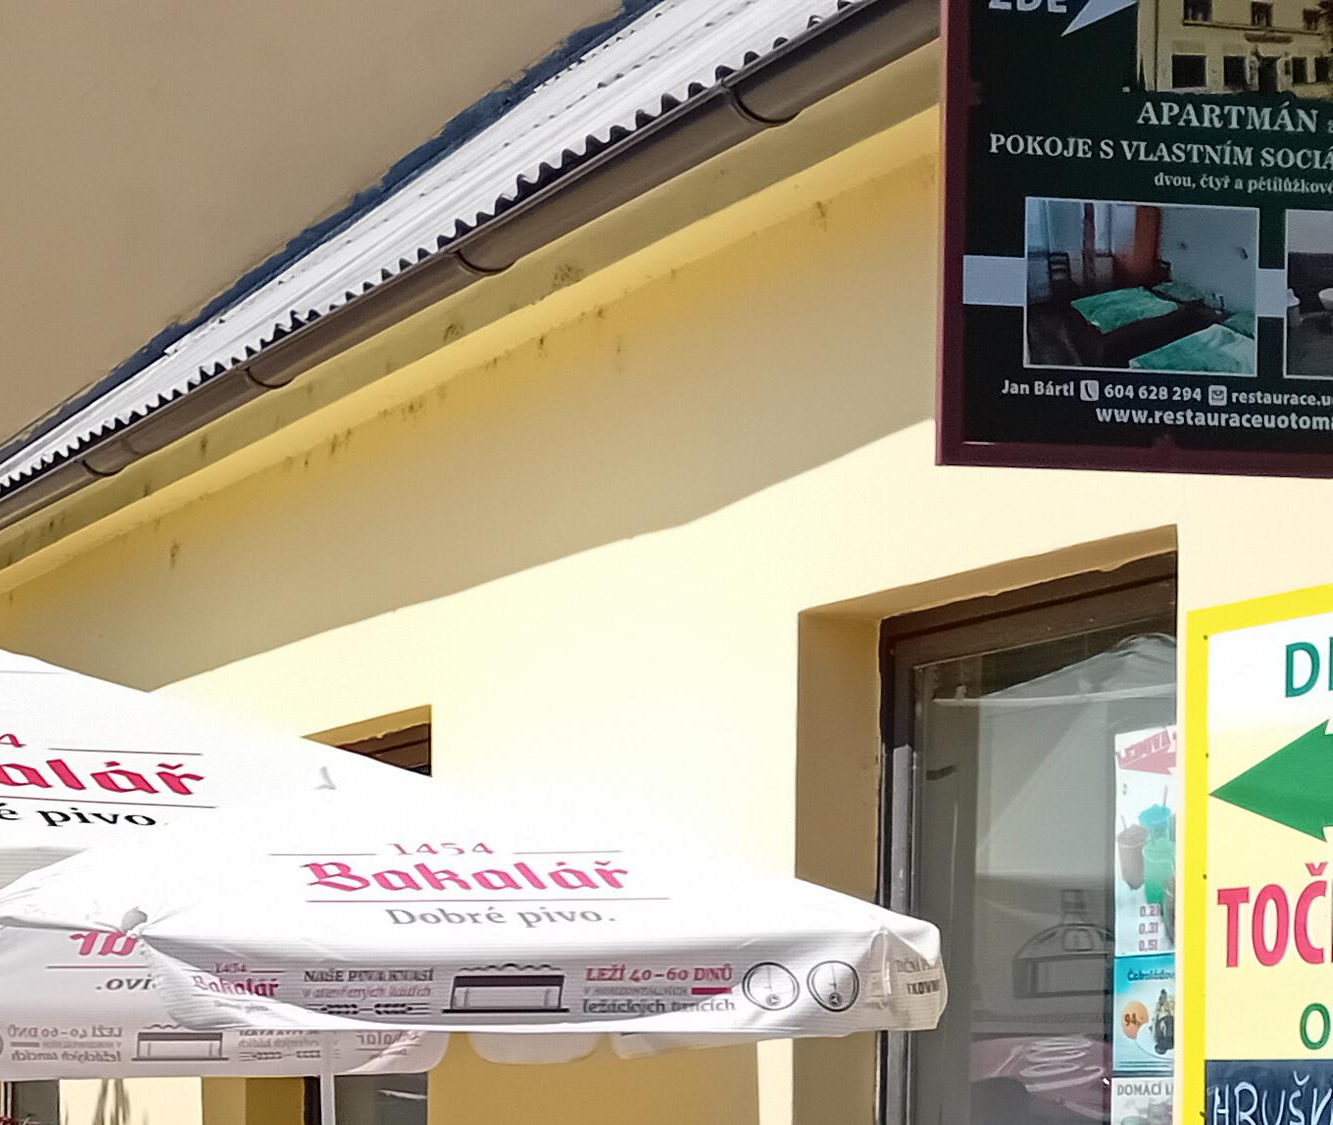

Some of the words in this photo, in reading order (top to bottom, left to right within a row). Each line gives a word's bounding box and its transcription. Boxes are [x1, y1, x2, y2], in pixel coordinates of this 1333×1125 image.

[1137, 100, 1319, 133] APARTMÁN
[989, 132, 1093, 159] POKOJE
[1099, 140, 1114, 160] S
[1120, 139, 1254, 167] VLASTNÍM
[1154, 172, 1196, 190] dvou,
[1200, 174, 1231, 192] čtyř
[1234, 179, 1243, 190] a
[1002, 380, 1030, 396] Jan
[1033, 380, 1074, 397] Bártl
[1104, 384, 1134, 399] 604
[1138, 385, 1168, 400] 628
[1172, 386, 1202, 402] 294
[1232, 391, 1333, 406] restaurace.u
[1096, 405, 1333, 431] www.restauraceuotom
[386, 841, 495, 857] 1454
[299, 861, 629, 892] Bakalář
[386, 906, 507, 926] Dobré
[517, 906, 616, 928] pivo.
[1217, 861, 1333, 968] TOČ
[192, 974, 281, 997] Bakalář
[1117, 1081, 1163, 1097] DOMÁCÍ
